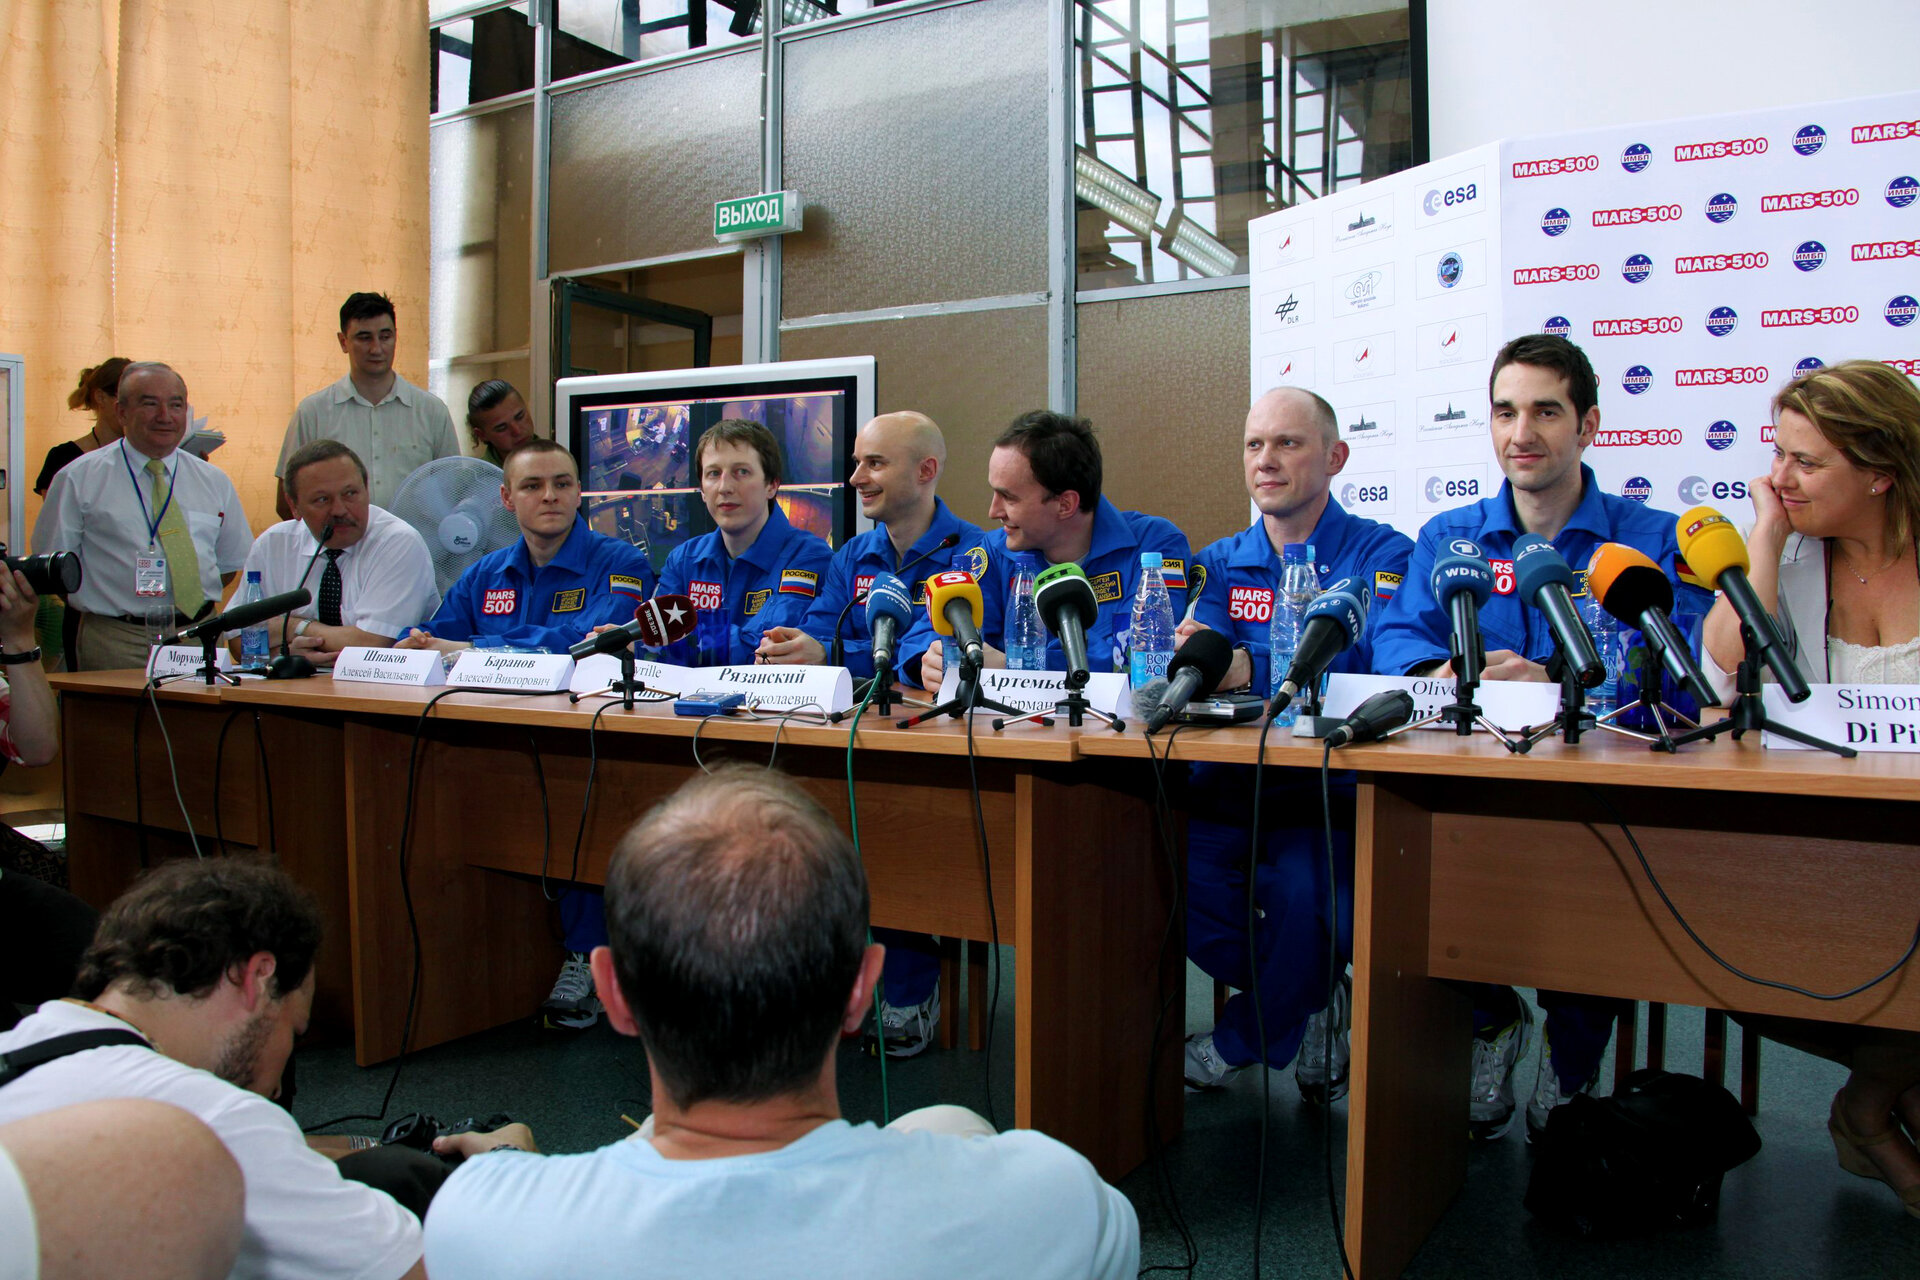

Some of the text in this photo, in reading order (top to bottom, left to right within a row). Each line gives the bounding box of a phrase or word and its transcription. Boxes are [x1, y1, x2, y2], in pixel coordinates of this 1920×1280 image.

[1794, 135, 1825, 144] ИМБП
[1676, 139, 1767, 161] MARS-500
[1623, 154, 1650, 163] ИМБП
[1514, 156, 1598, 177] MARS-500
[1444, 184, 1477, 206] esa
[1888, 187, 1918, 197] ИМБП
[1708, 203, 1735, 212] ИМБП
[1762, 190, 1858, 212] MARS-500
[719, 198, 780, 228] ВЫХОД
[1594, 206, 1681, 226] MARS-500
[1676, 253, 1767, 273] MARS-500
[1795, 251, 1824, 260] ИМБП
[1515, 265, 1598, 284] MARS-500
[1624, 264, 1650, 273] ИМБП
[1762, 307, 1858, 327] MARS-500
[1887, 307, 1917, 316] ИМБП
[1287, 315, 1299, 324] DLR
[1594, 318, 1681, 335] MARS-500
[1708, 317, 1735, 326] ИМБП
[1624, 375, 1651, 384] ИМБП
[1676, 368, 1767, 385] MARS-500
[1595, 431, 1681, 445] MARS-500
[1707, 431, 1735, 440] ИМБП
[1359, 486, 1388, 502] esa
[1446, 479, 1479, 497] esa
[1623, 488, 1650, 496] ИМБП
[1712, 481, 1750, 500] es
[784, 570, 816, 580] РОССИЯ
[1445, 567, 1479, 579] WDR
[1488, 562, 1513, 574] RS
[612, 575, 640, 585] РОССИЯ
[857, 577, 875, 588] MA
[940, 572, 967, 583] 5
[1038, 567, 1072, 586] RT
[1380, 573, 1402, 584] РОСС
[486, 590, 515, 600] MARS
[690, 582, 721, 595] MARS
[1231, 587, 1271, 602] MARS
[484, 600, 515, 614] 500
[689, 593, 720, 609] 500
[1229, 602, 1270, 621] 500
[363, 650, 408, 664] Шпаков
[484, 655, 536, 670] Баранов
[340, 666, 420, 681] Алексей Васильевич
[635, 664, 662, 678] yrille
[718, 667, 806, 684] Рязанский
[455, 671, 551, 687] Алексей Викторович
[983, 673, 1065, 691] Артемье
[1412, 680, 1457, 696] Olive
[1001, 696, 1056, 711] Герман
[1845, 721, 1920, 745] Di Pi
